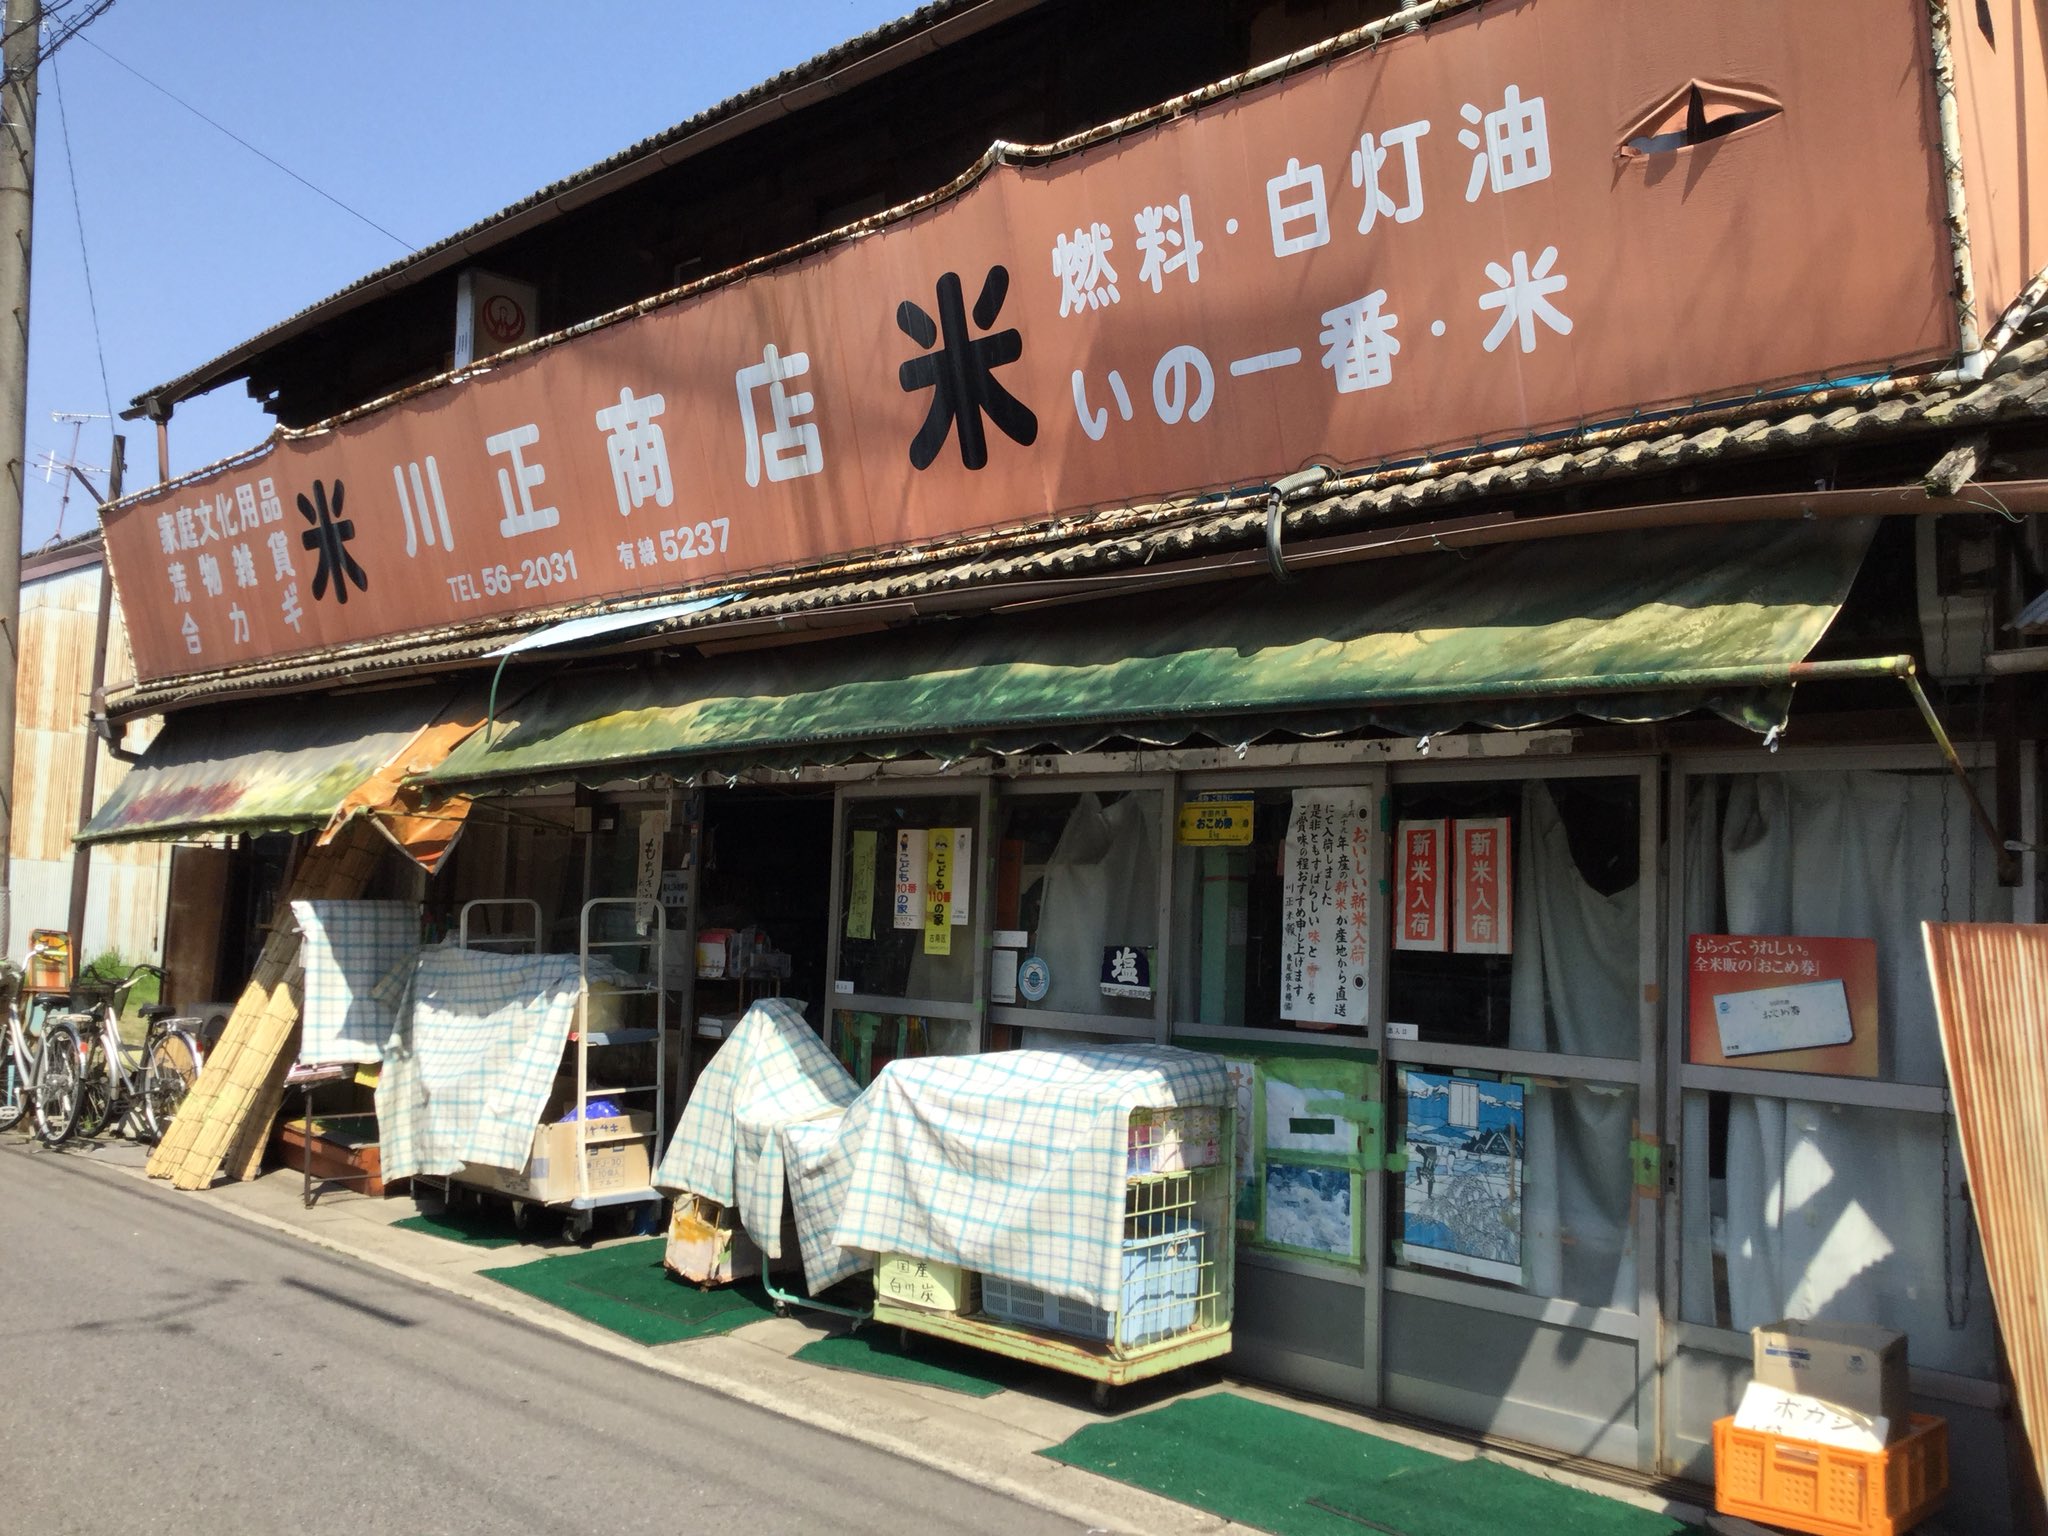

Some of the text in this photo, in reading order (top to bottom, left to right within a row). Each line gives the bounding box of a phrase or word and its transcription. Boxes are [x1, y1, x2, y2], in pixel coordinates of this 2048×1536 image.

[1052, 84, 1552, 317] 燃料・白灯油
[896, 265, 1039, 471] 米
[1071, 246, 1574, 441] いの一番・米
[393, 343, 824, 558] 川正商店
[157, 477, 284, 555] 家庭文化用品
[168, 530, 296, 604] 荒物雑貨
[297, 479, 368, 604] 米
[659, 517, 730, 562] 5237
[447, 548, 578, 603] TEL 56-2031
[1410, 832, 1434, 938] 新米入荷
[1470, 831, 1494, 940] 新米入荷
[1111, 946, 1139, 985] 塩
